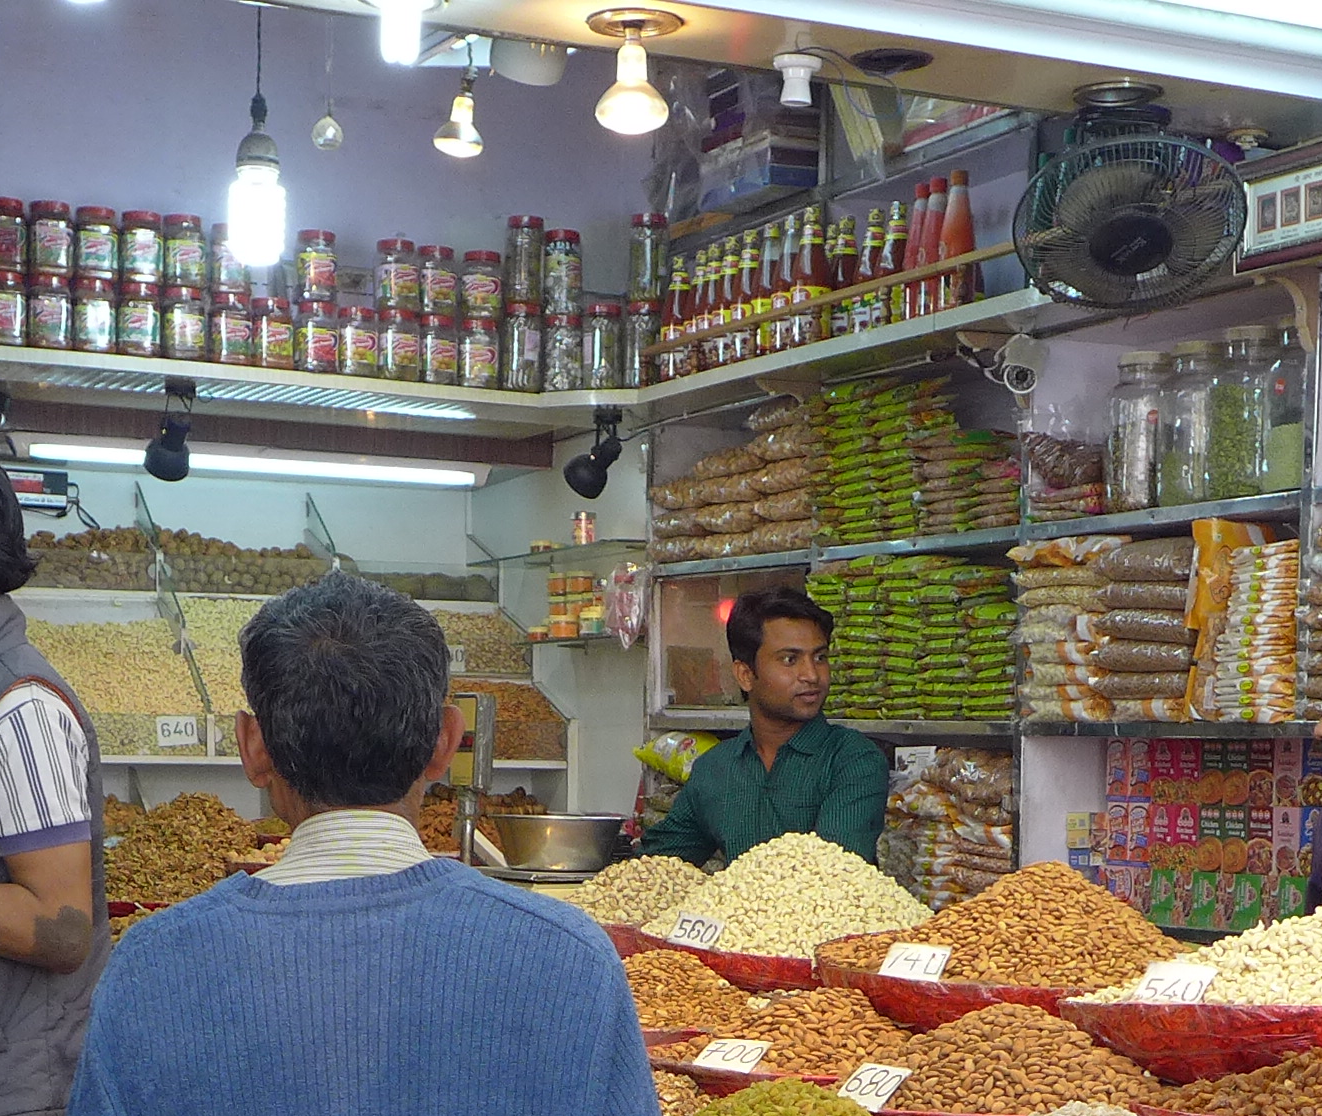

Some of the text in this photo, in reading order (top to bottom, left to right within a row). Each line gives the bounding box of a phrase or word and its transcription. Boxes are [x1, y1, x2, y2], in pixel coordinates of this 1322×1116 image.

[160, 720, 196, 738] 640
[674, 918, 719, 944] 560
[705, 1042, 765, 1065] 700
[845, 1067, 902, 1098] 680
